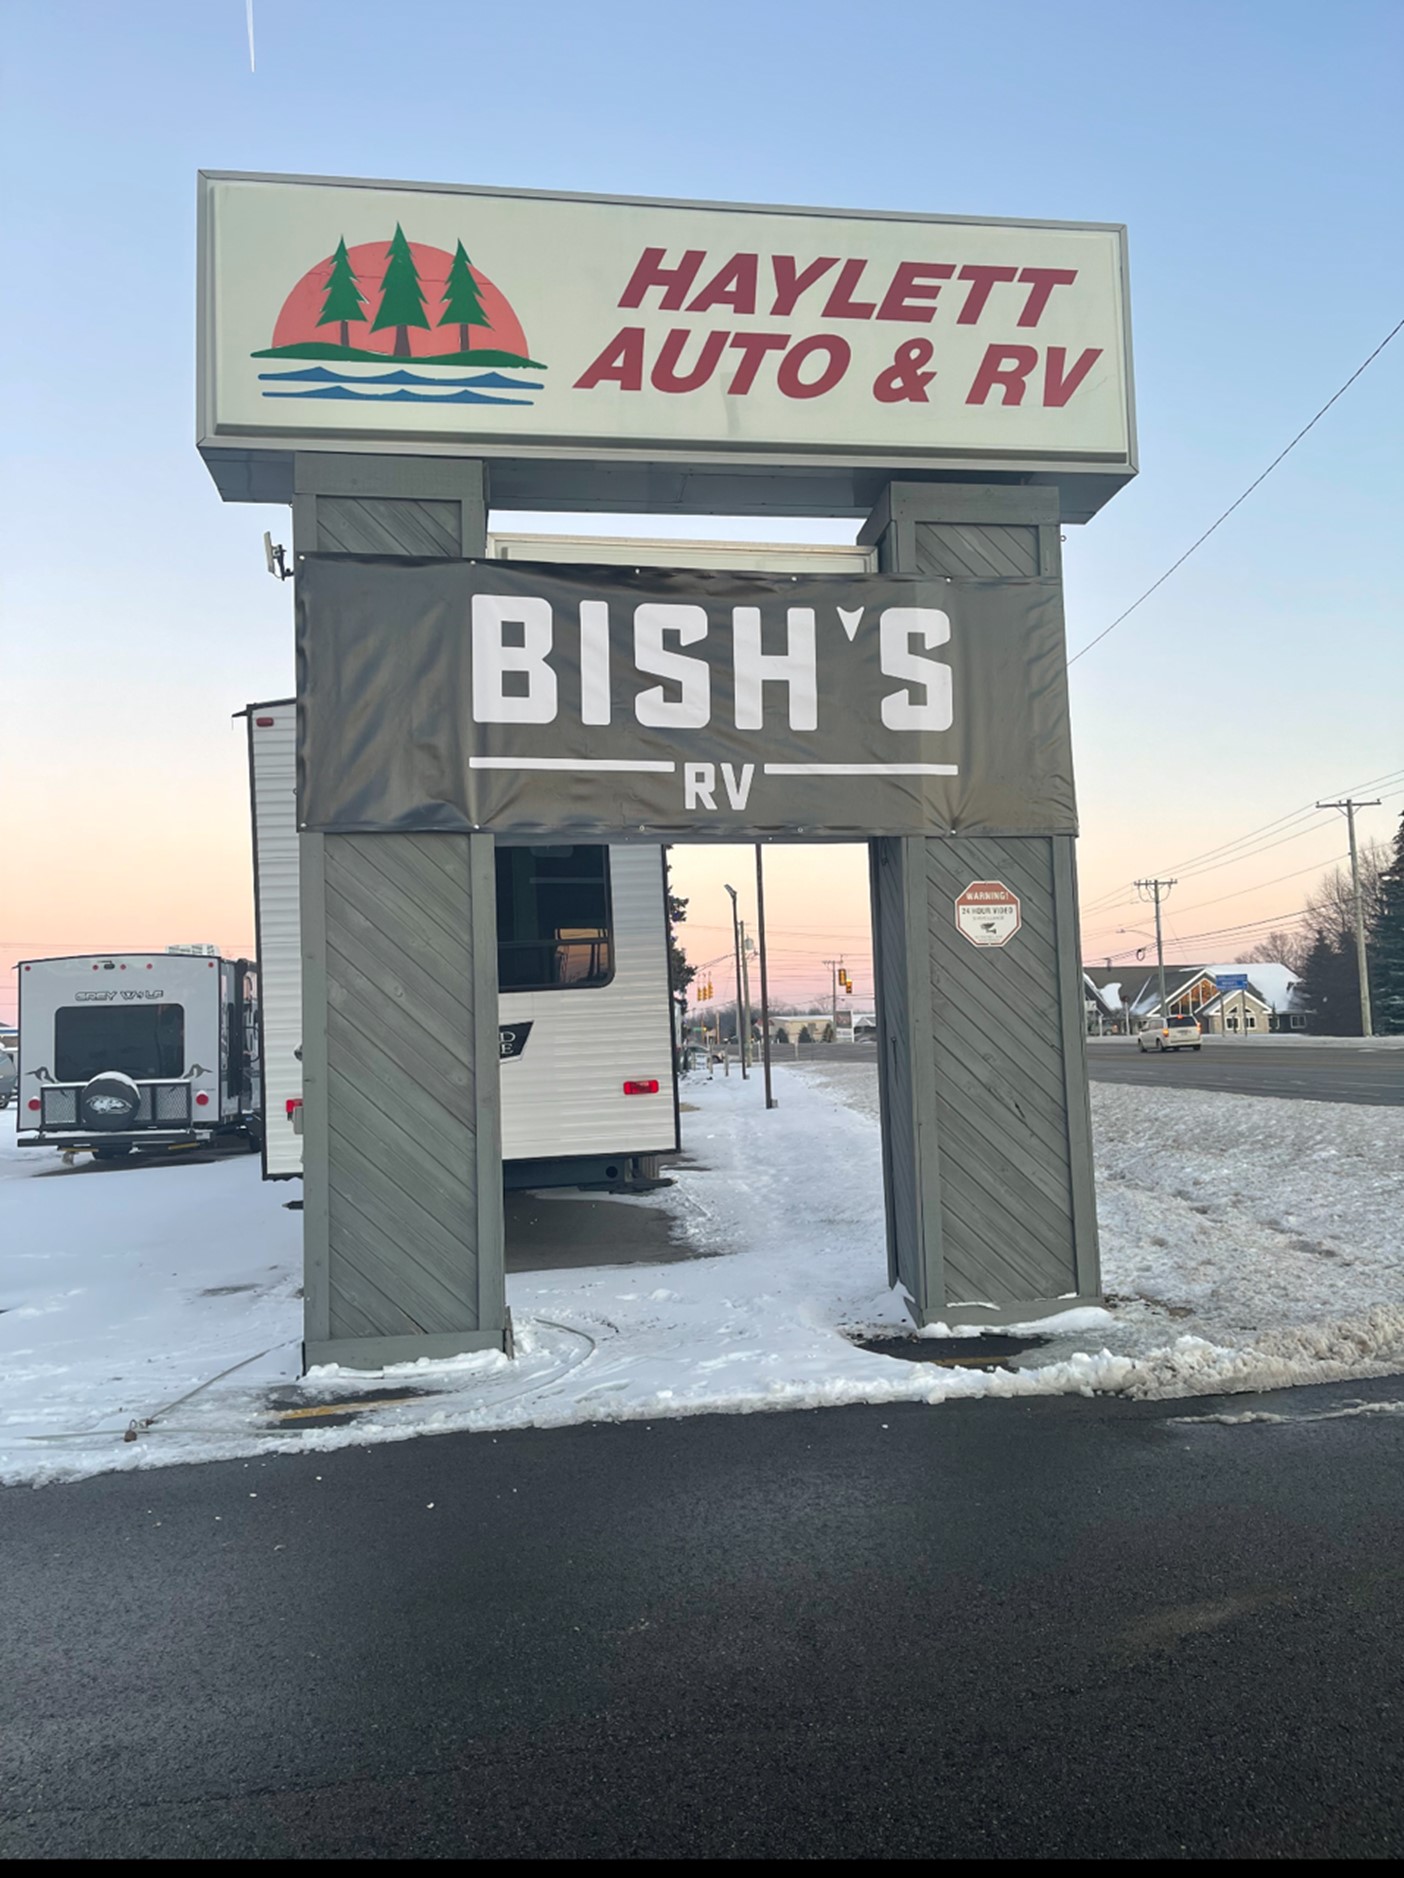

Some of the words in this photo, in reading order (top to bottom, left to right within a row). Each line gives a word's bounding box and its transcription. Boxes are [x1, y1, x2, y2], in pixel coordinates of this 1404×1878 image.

[618, 248, 1076, 328] HAYLETT
[574, 327, 851, 399] AUTO
[873, 339, 935, 403] &
[966, 345, 1102, 408] RV
[471, 593, 955, 732] BISH'S
[683, 761, 756, 811] RV
[966, 892, 1009, 900] WARNING!
[75, 991, 117, 1002] GREY
